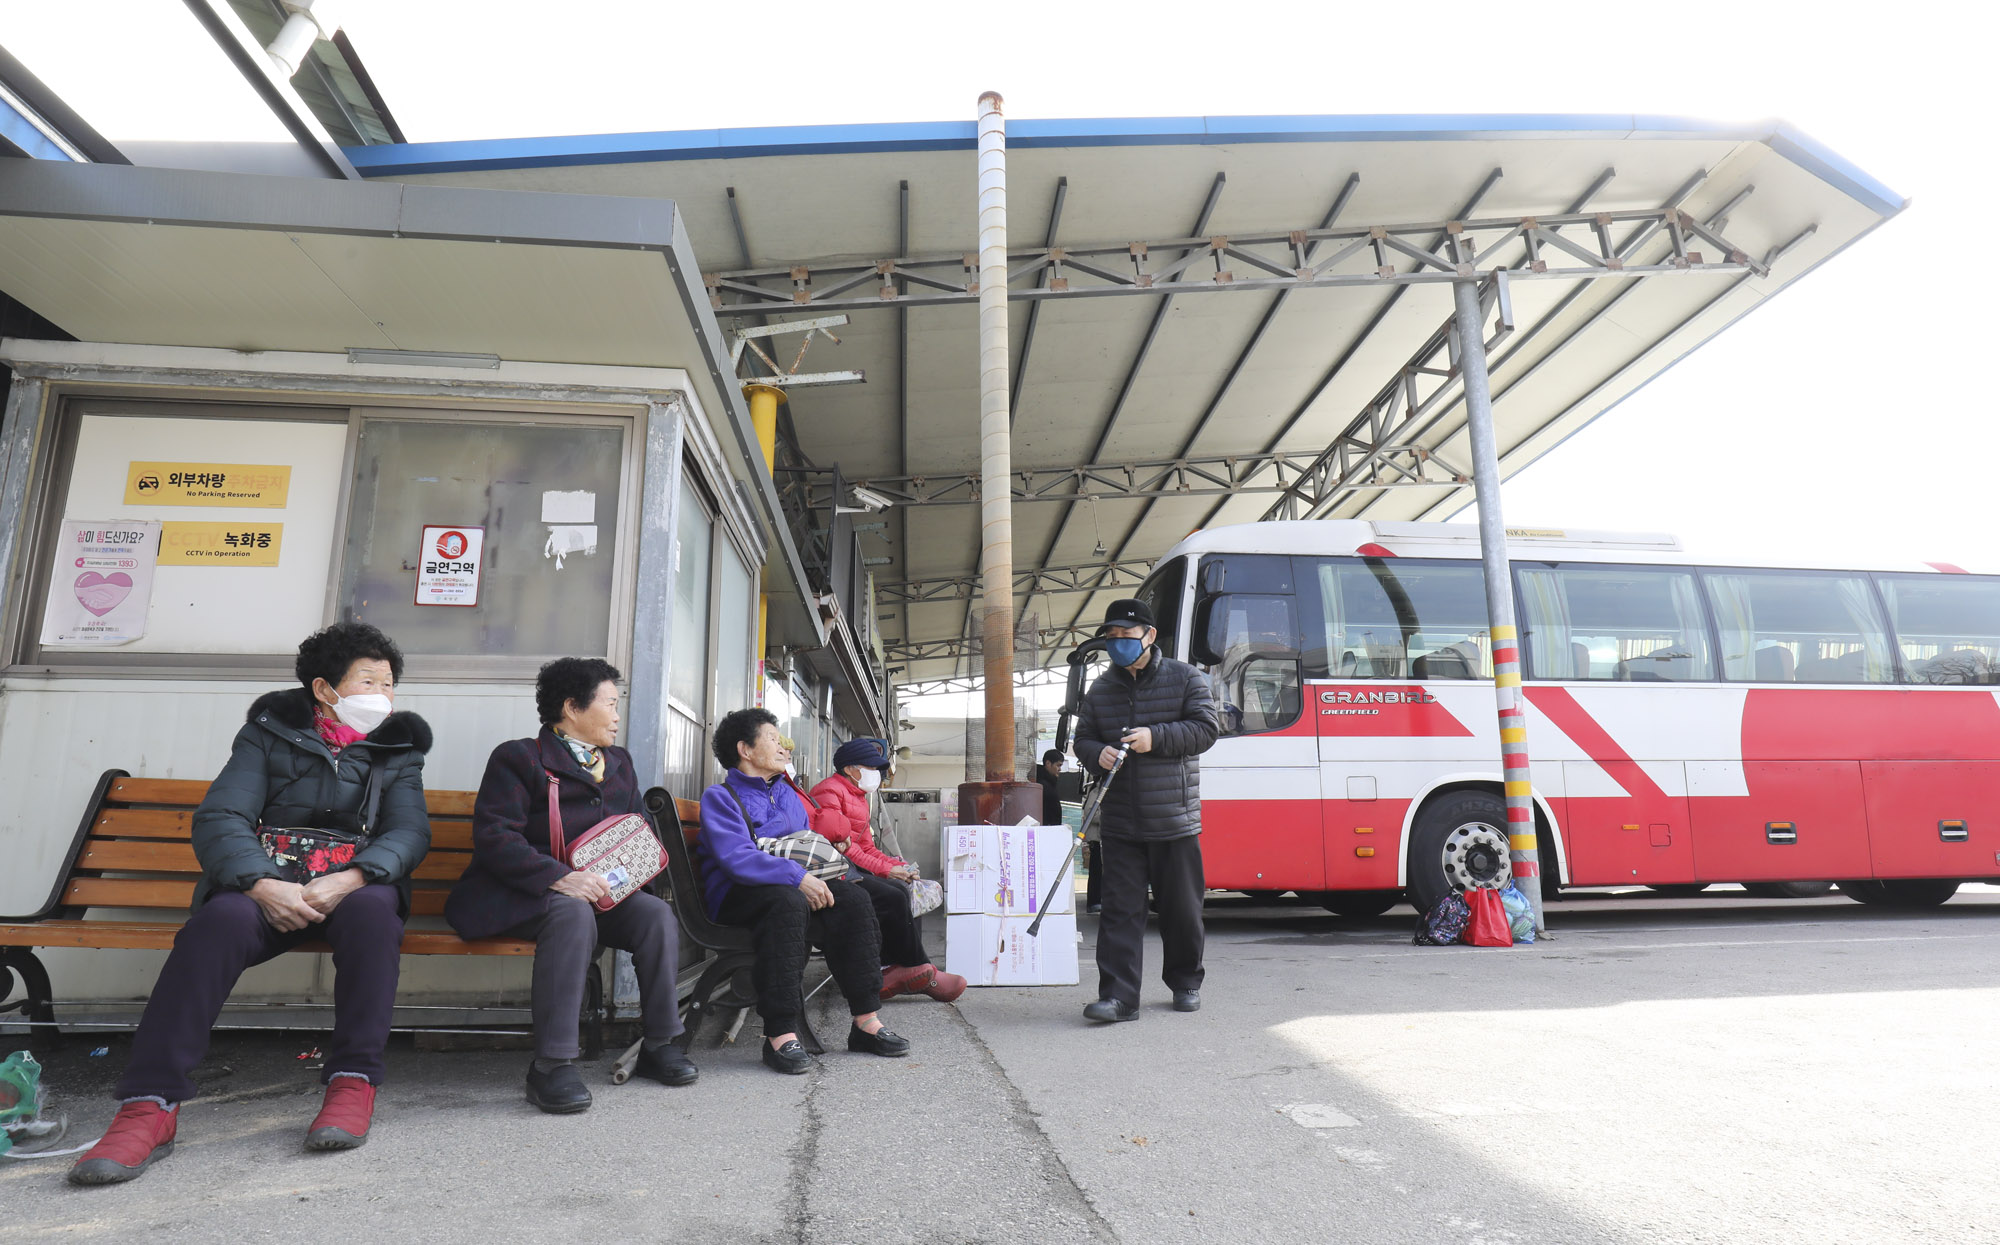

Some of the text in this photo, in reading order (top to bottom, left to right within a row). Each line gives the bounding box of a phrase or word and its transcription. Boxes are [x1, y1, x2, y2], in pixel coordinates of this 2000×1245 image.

[168, 472, 226, 488] 외부차량
[77, 530, 145, 544] 삶이 힘드신가요?
[224, 532, 272, 548] 녹화중
[214, 550, 251, 558] Operation
[426, 561, 475, 575] 금연구역
[1320, 691, 1437, 704] GRANBIRD
[959, 835, 967, 848] 450
